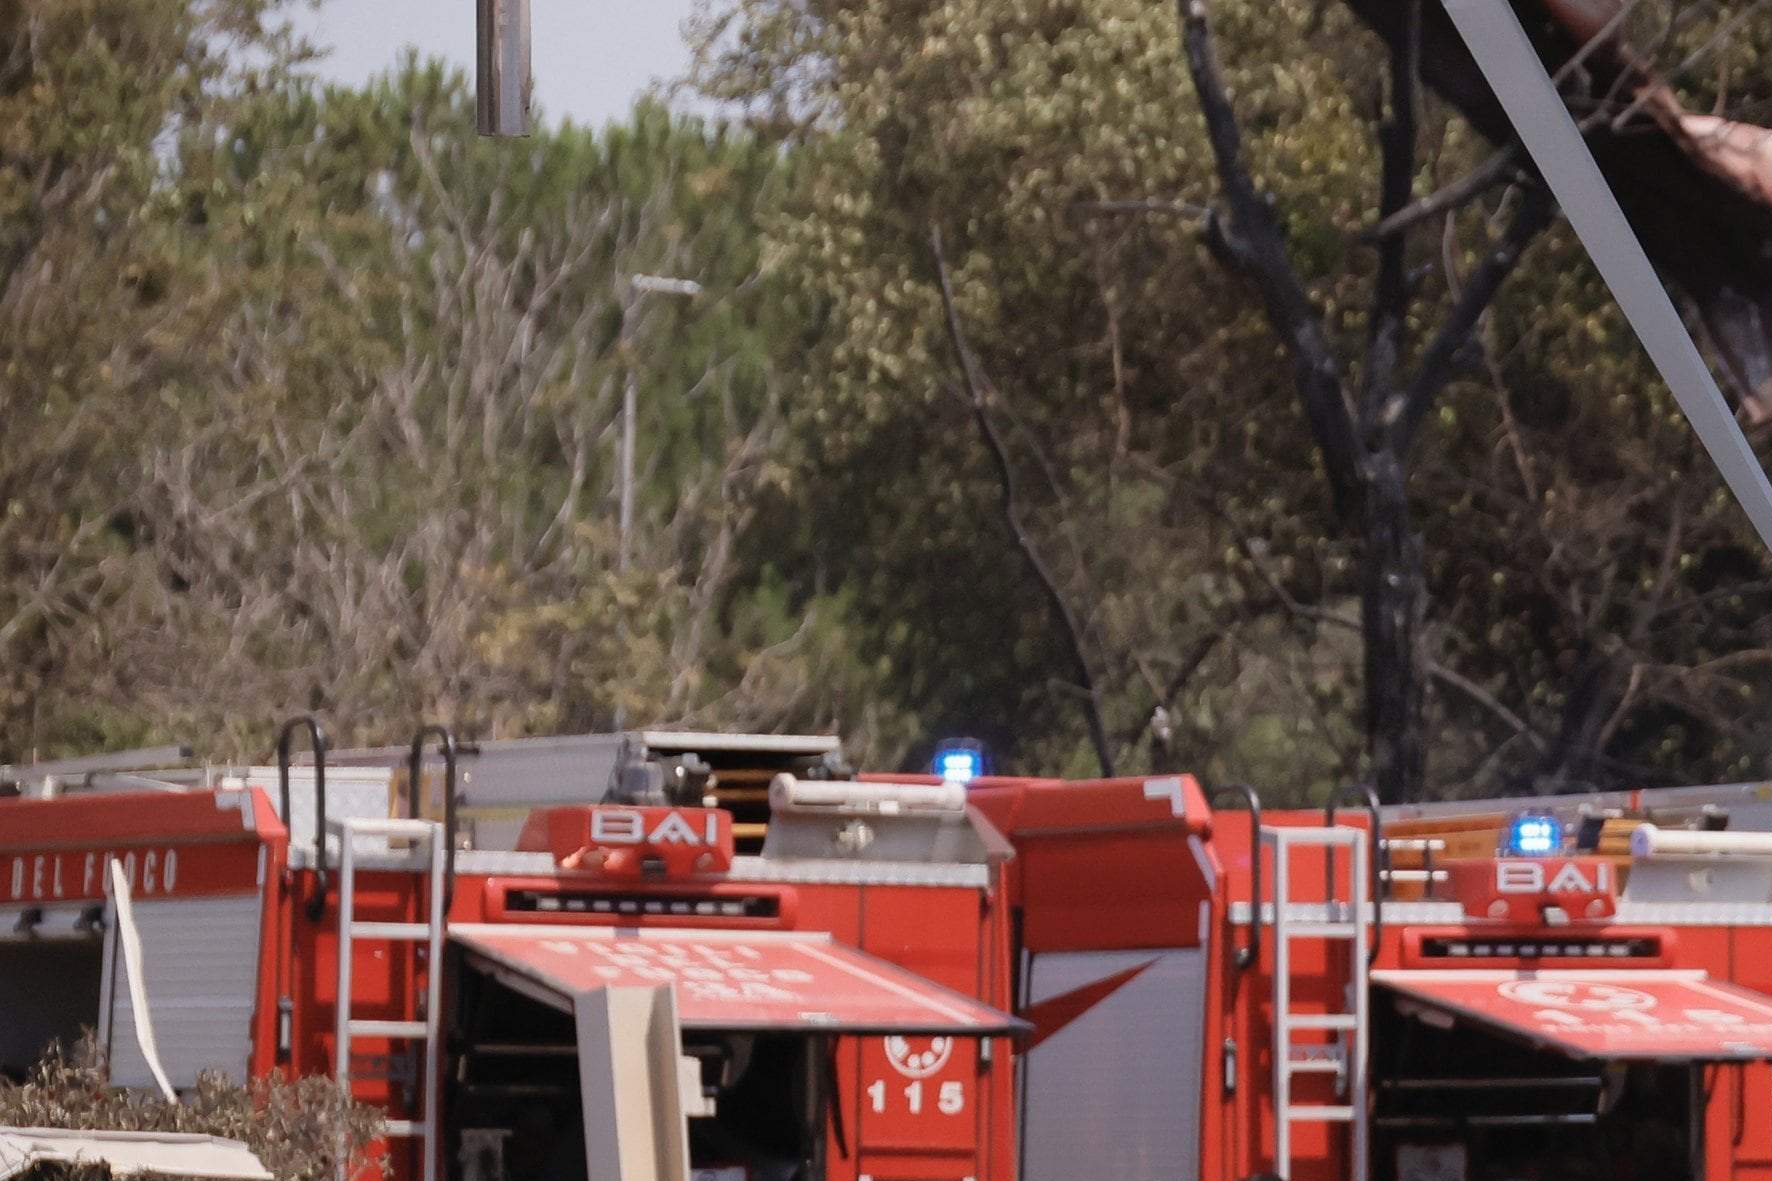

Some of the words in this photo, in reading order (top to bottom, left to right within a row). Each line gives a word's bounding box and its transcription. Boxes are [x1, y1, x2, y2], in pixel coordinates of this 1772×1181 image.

[591, 810, 719, 845] BAI
[11, 855, 64, 899] DEL
[83, 848, 178, 896] FUOCO
[1497, 862, 1610, 894] BAI
[866, 1080, 965, 1115] 115
